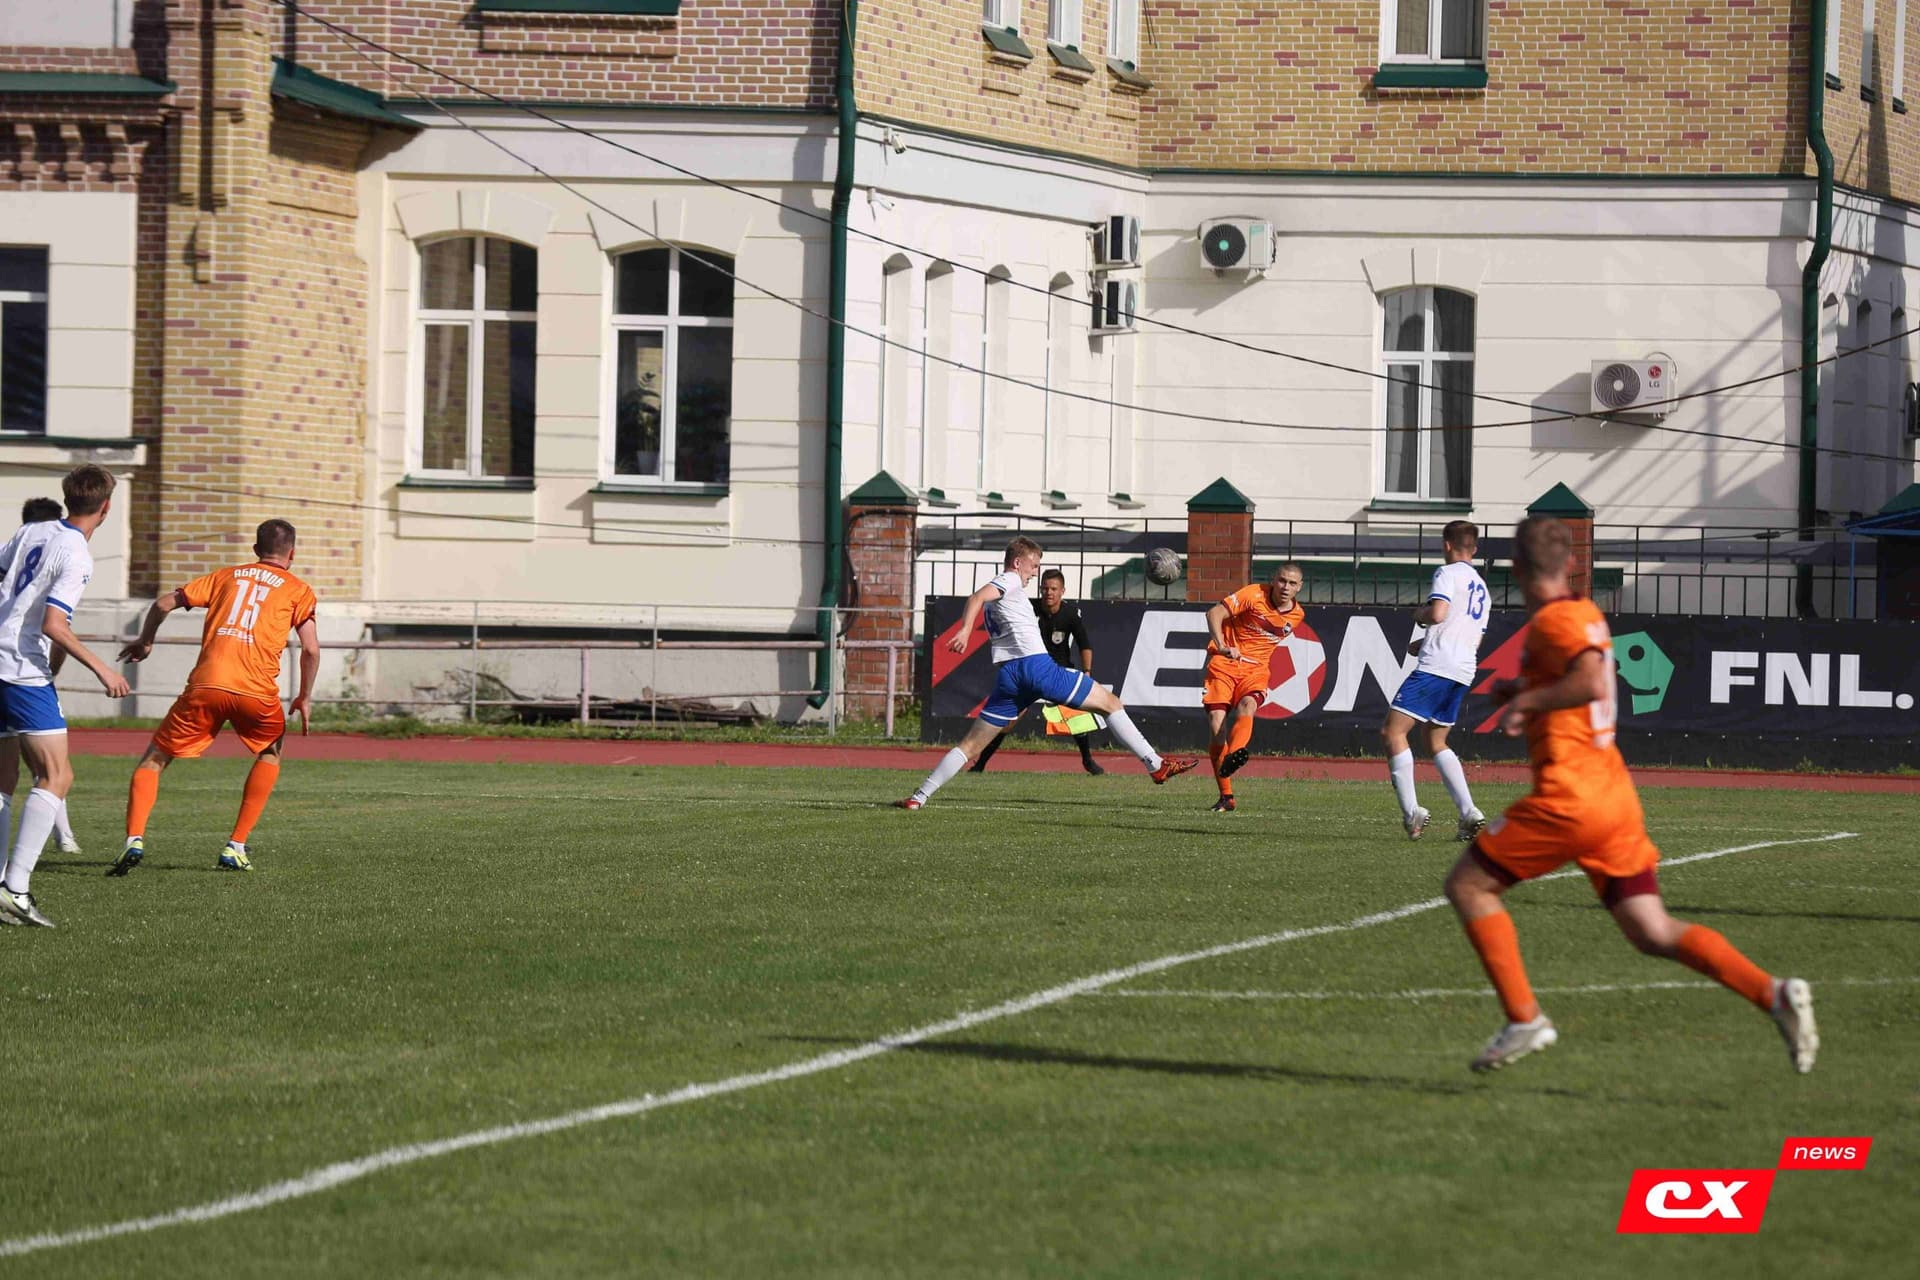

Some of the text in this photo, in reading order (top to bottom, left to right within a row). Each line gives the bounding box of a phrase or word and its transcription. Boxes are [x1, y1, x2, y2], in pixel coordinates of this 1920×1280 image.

[1648, 381, 1661, 389] LG
[15, 546, 43, 597] 8
[226, 579, 271, 630] 15
[1466, 580, 1486, 620] 13
[1709, 650, 1915, 710] FNL.
